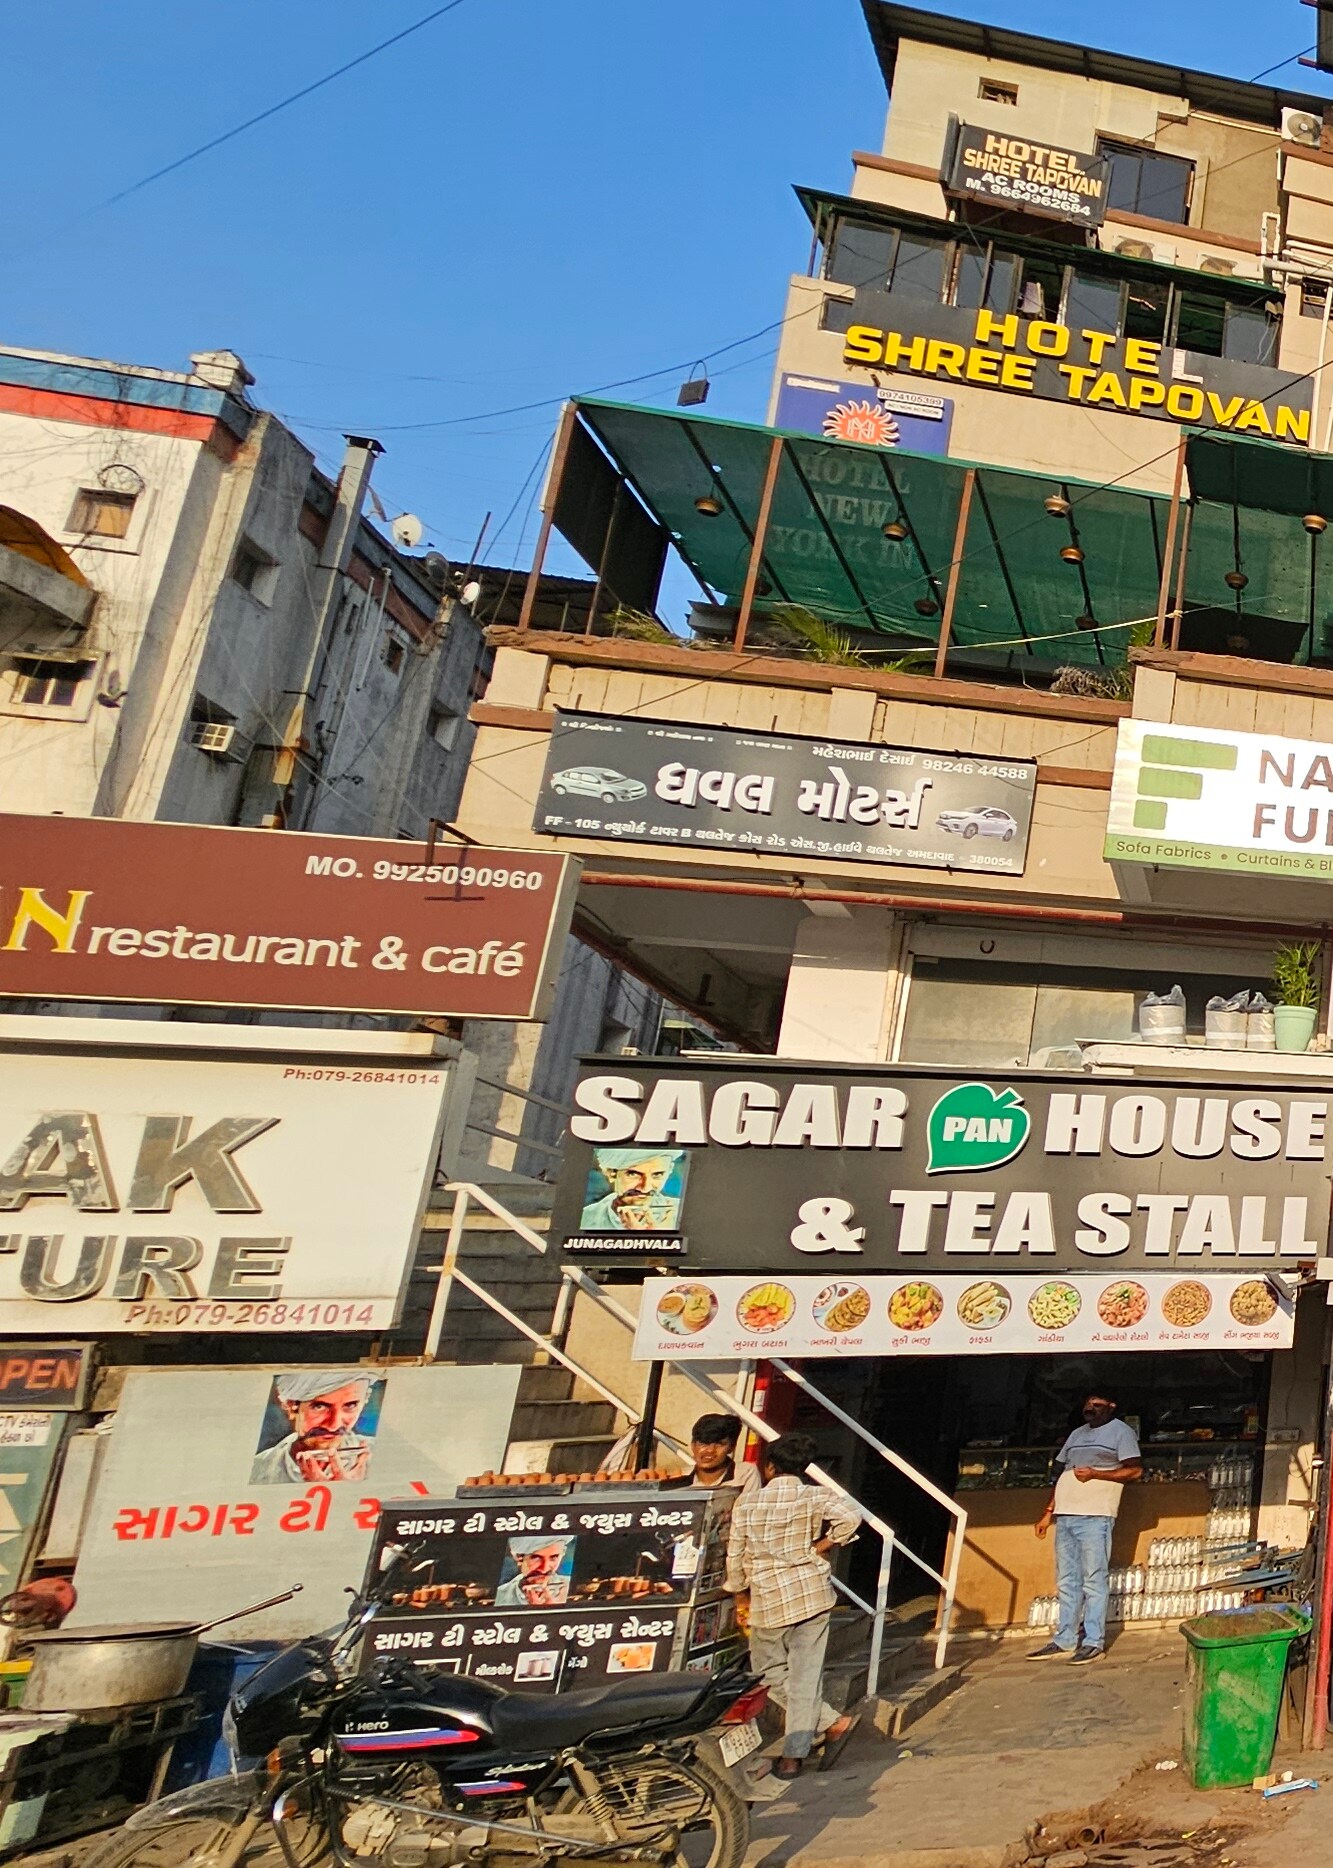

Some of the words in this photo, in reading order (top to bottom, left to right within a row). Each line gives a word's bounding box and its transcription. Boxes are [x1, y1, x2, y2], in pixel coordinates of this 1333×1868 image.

[985, 134, 1081, 173] HOTEL
[963, 148, 1022, 179] SHREE
[1025, 163, 1102, 198] TAPOVAN
[965, 177, 986, 192] M.
[981, 172, 1008, 186] AC
[1012, 180, 1080, 203] ROOMS
[976, 310, 1204, 384] HOTEL
[844, 325, 1037, 391] SHREE
[1059, 363, 1312, 442] TAPOVAN
[879, 750, 915, 767] દેસાઈ
[922, 758, 973, 775] 98246
[976, 763, 1028, 780] 44588
[797, 765, 934, 830] મોટર્સ
[575, 818, 601, 830] 105
[650, 826, 678, 837] ટાવર
[680, 828, 692, 838] B
[766, 834, 786, 847] રોડ
[906, 849, 954, 862] અમદાવાદ
[969, 854, 1013, 868] 380054
[1116, 840, 1151, 855] Sofa
[1155, 844, 1212, 861] Fabrics
[1236, 852, 1301, 868] Curtains
[1304, 858, 1316, 870] &
[304, 855, 364, 880] MO.
[373, 860, 543, 891] 9925090960
[87, 925, 361, 969] restaurant
[372, 935, 407, 972] &
[421, 938, 526, 978] café
[283, 1069, 440, 1086] Ph:079-26841014
[571, 1075, 908, 1149] SAGAR
[942, 1114, 1013, 1144] PAN
[1044, 1092, 1329, 1161] HOUSE
[790, 1196, 866, 1254] &
[890, 1189, 1056, 1255] TEA
[1074, 1191, 1318, 1256] STALL
[563, 1236, 682, 1253] JUNAGADHVALA
[124, 1305, 374, 1327] Ph:079-26841014
[0, 1358, 82, 1390] PEN
[112, 1500, 262, 1541] સાગર
[278, 1485, 333, 1534] ટી
[396, 1516, 456, 1536] સાગર
[463, 1512, 486, 1534] ટી
[494, 1511, 543, 1533] સ્ટોલ
[551, 1512, 571, 1529] &
[641, 1506, 693, 1528] સેન્ટર
[373, 1629, 433, 1650] સાગર
[441, 1623, 465, 1647] ટી
[473, 1622, 522, 1646] સ્ટોલ
[528, 1625, 549, 1643] &
[620, 1616, 675, 1638] સેન્ટર
